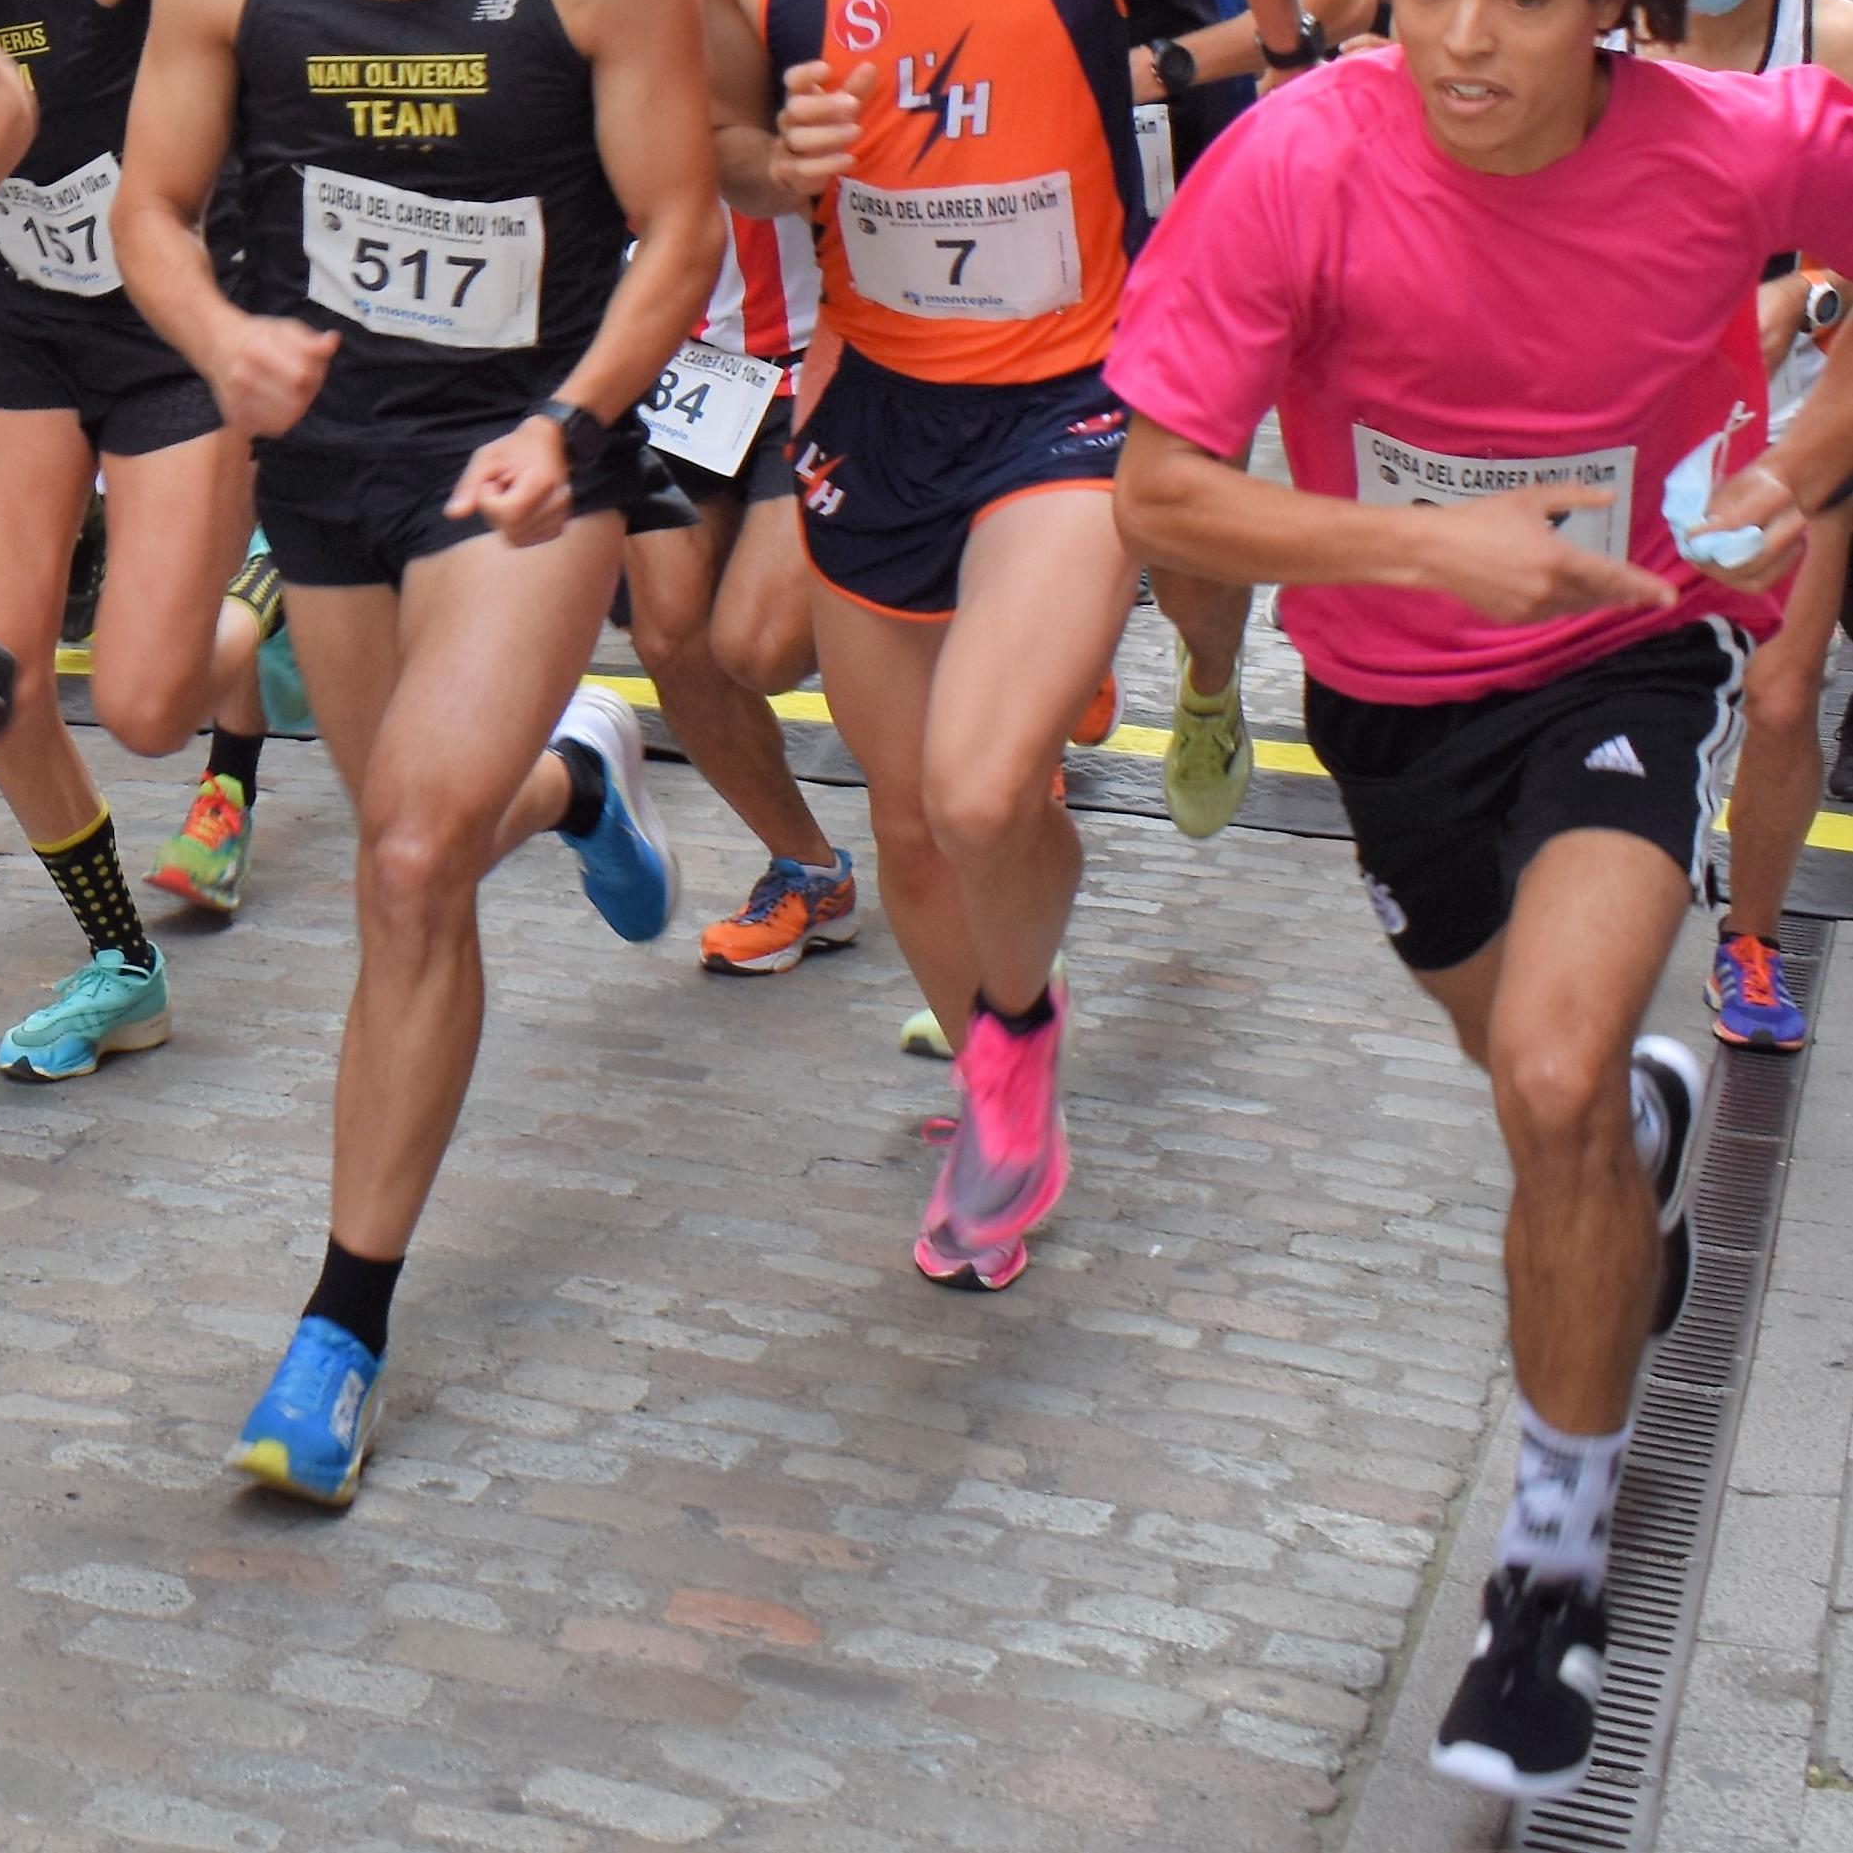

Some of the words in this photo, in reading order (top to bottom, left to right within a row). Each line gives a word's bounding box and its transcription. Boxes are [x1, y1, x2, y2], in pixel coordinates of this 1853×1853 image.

[364, 60, 489, 88] OLIVERAS
[346, 100, 459, 137] TEAM
[317, 181, 363, 219] CURSA
[366, 195, 392, 221] DEL
[395, 203, 450, 234] CARRER
[455, 211, 486, 236] NOU
[491, 214, 527, 238] 10km
[849, 188, 894, 219] CURSA
[897, 200, 924, 221] DEL
[927, 198, 982, 221] CARRER
[987, 195, 1018, 216] NOU
[1022, 187, 1058, 213] 10km
[351, 236, 488, 308] 517
[934, 239, 977, 286] 7
[1372, 439, 1420, 477] CURSA
[1425, 461, 1456, 487] DEL
[1460, 468, 1528, 491] CARRER
